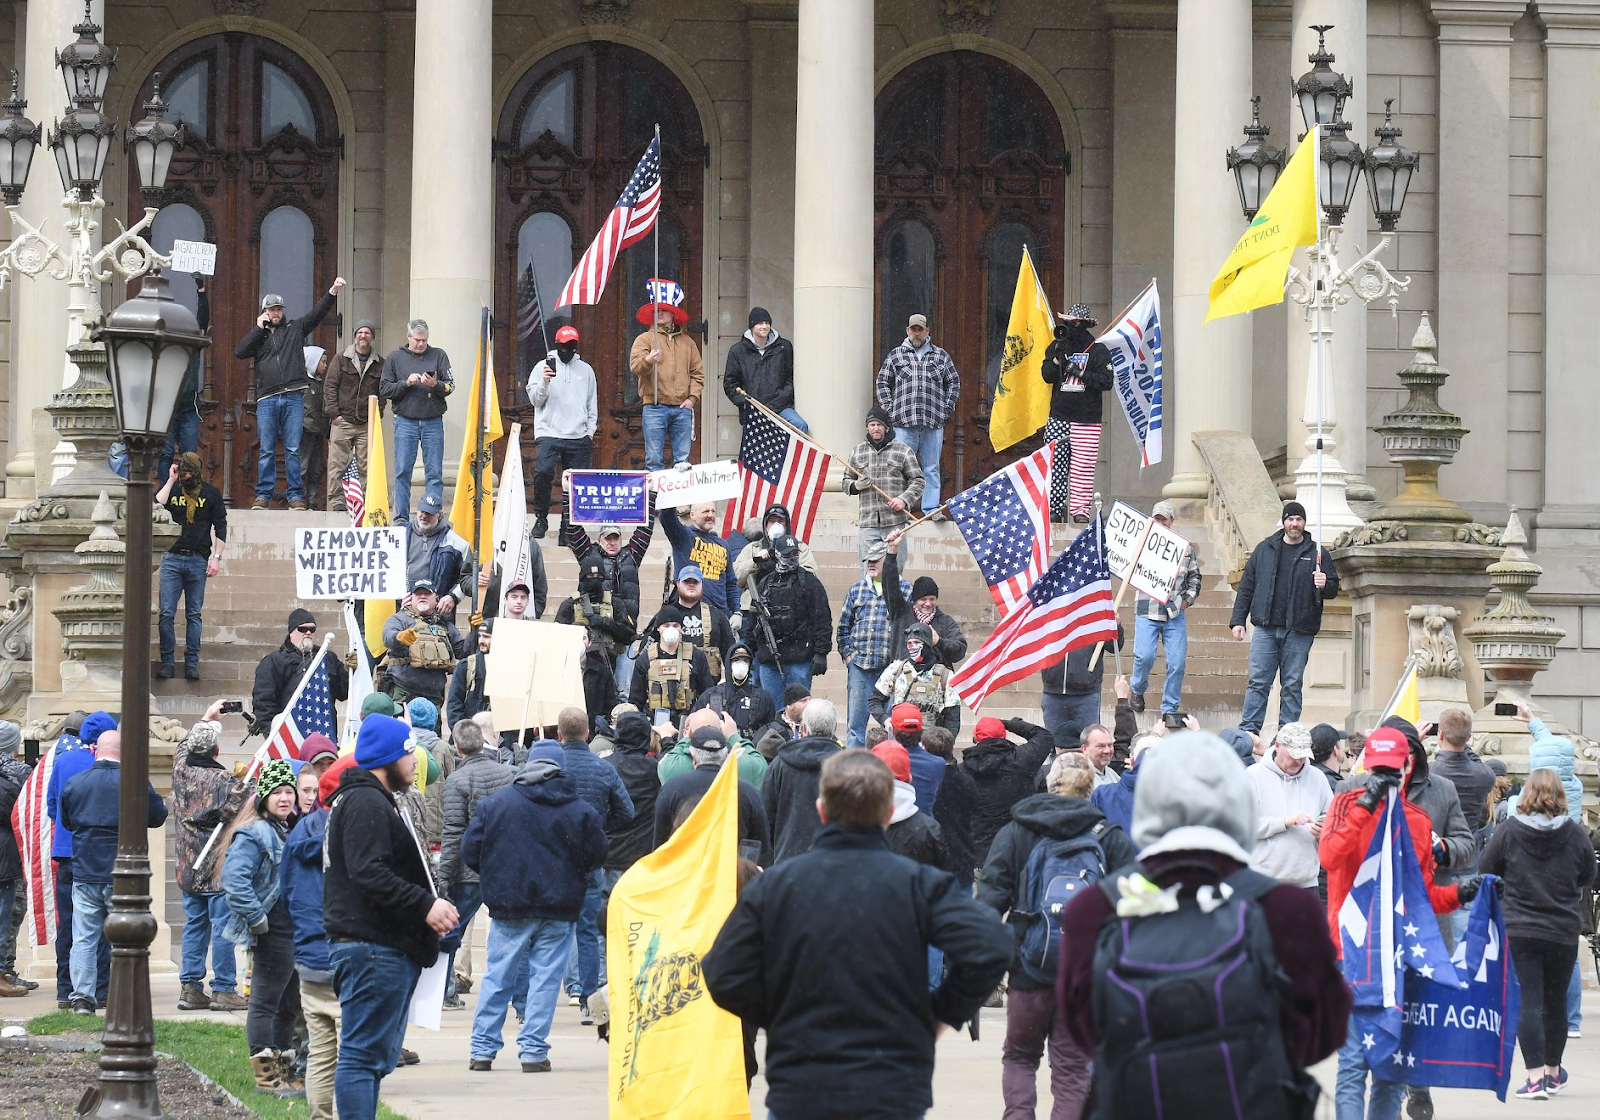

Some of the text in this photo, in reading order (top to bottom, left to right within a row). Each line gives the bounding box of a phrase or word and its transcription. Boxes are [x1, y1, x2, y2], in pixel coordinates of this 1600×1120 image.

[179, 255, 213, 273] HITLER
[1109, 346, 1149, 444] NO MORE BULLS
[574, 485, 643, 497] TRUMP
[657, 470, 738, 493] Recall Whitmer
[170, 495, 207, 508] ARY
[580, 497, 636, 505] PENCE
[1109, 508, 1145, 538] STOP
[302, 529, 400, 550] REMOVE THE
[1113, 533, 1128, 548] THE
[1147, 532, 1184, 566] OPEN
[298, 551, 390, 571] WHITMER
[1106, 548, 1131, 573] RANNY
[312, 571, 387, 595] REGIME
[1443, 1005, 1502, 1037] AGAIN
